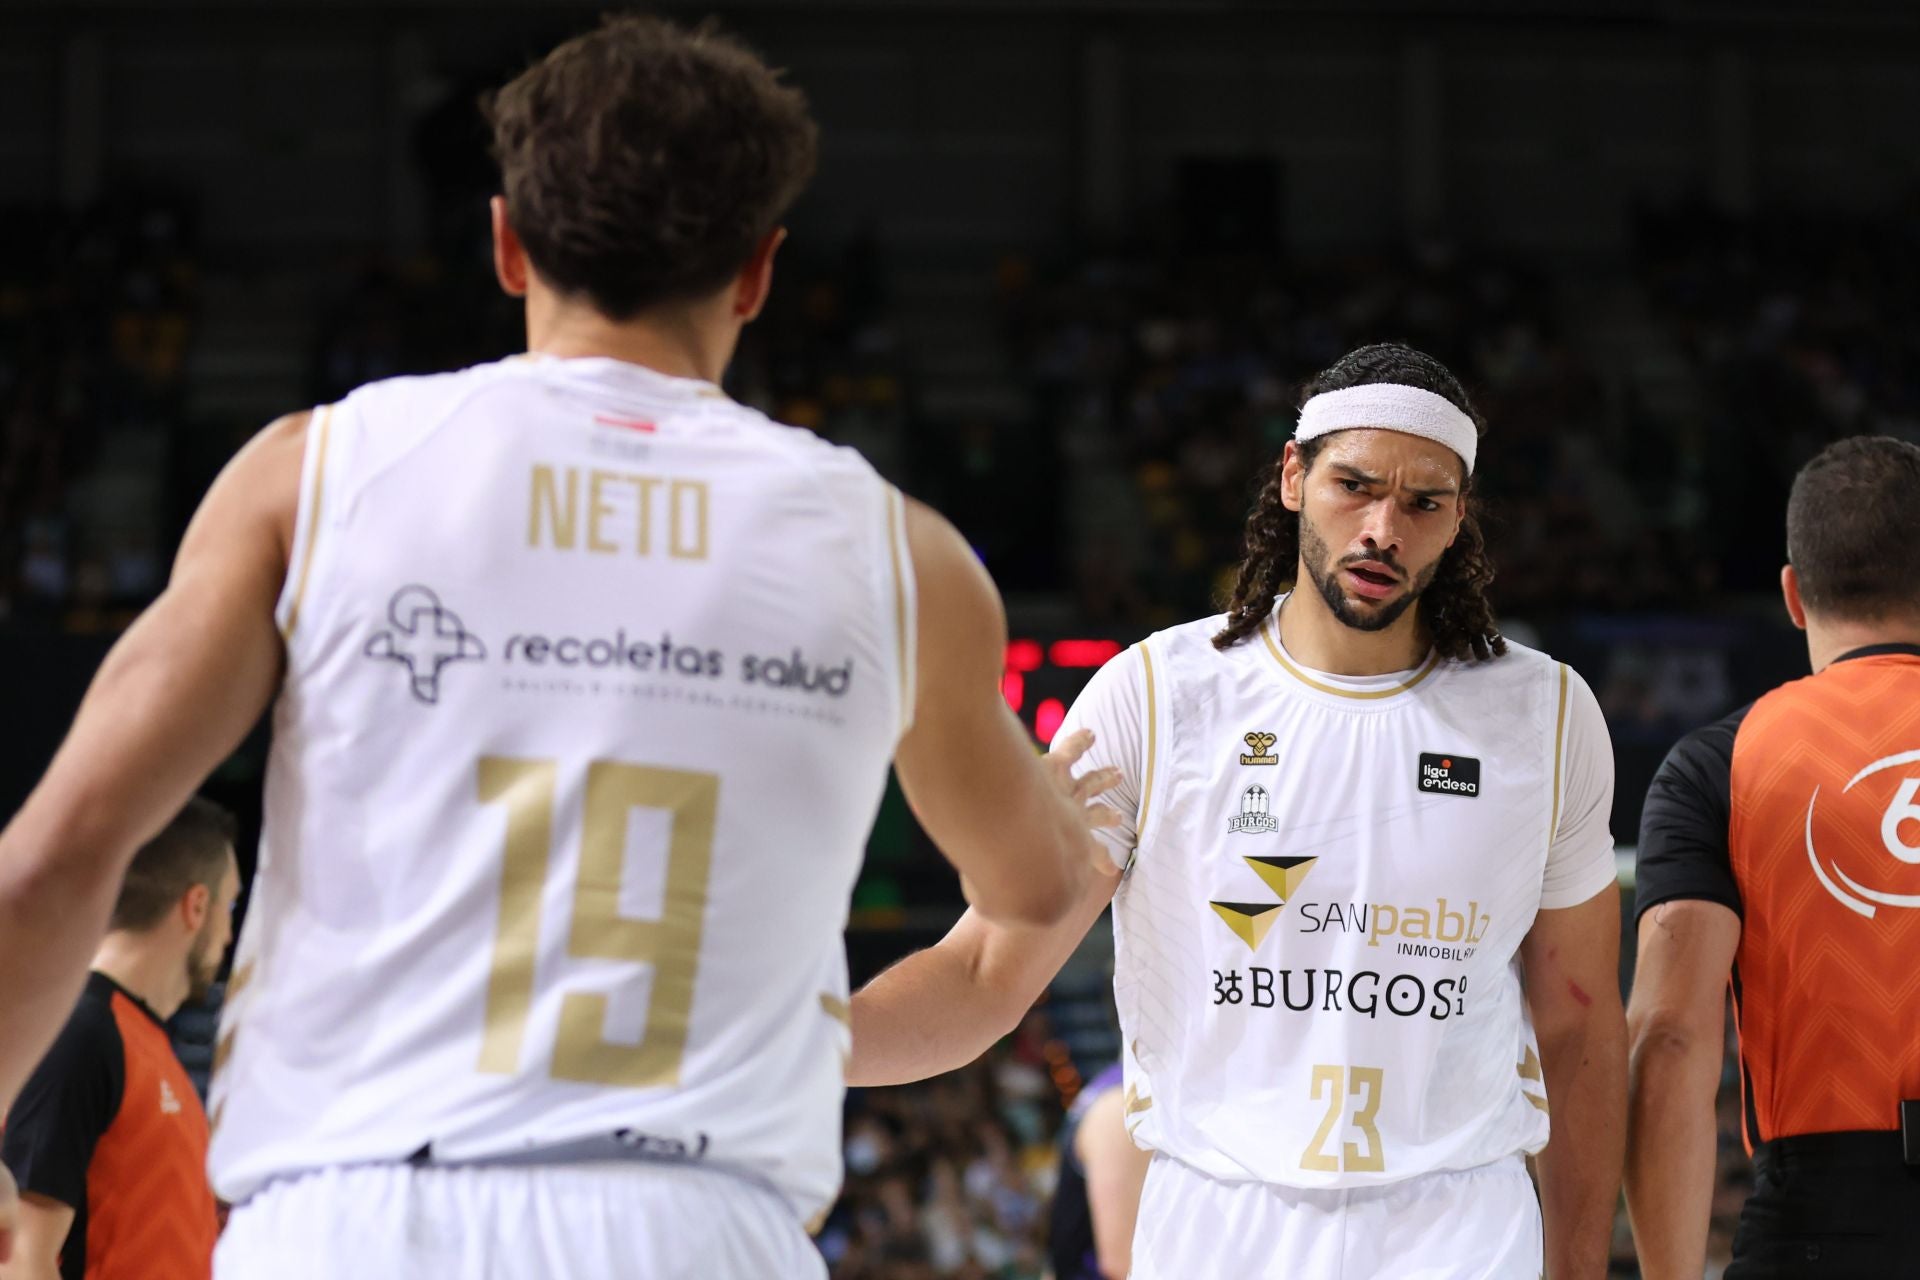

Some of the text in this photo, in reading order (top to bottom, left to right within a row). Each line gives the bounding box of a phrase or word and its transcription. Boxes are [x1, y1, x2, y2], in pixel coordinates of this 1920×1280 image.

[528, 463, 711, 561] NETO
[504, 628, 853, 697] recoletas salud
[1241, 754, 1277, 765] hummel
[1423, 764, 1449, 779] liga
[1423, 778, 1476, 793] endesa
[1233, 816, 1276, 829] BURGOS
[475, 754, 721, 1089] 19
[1298, 1064, 1385, 1173] 23
